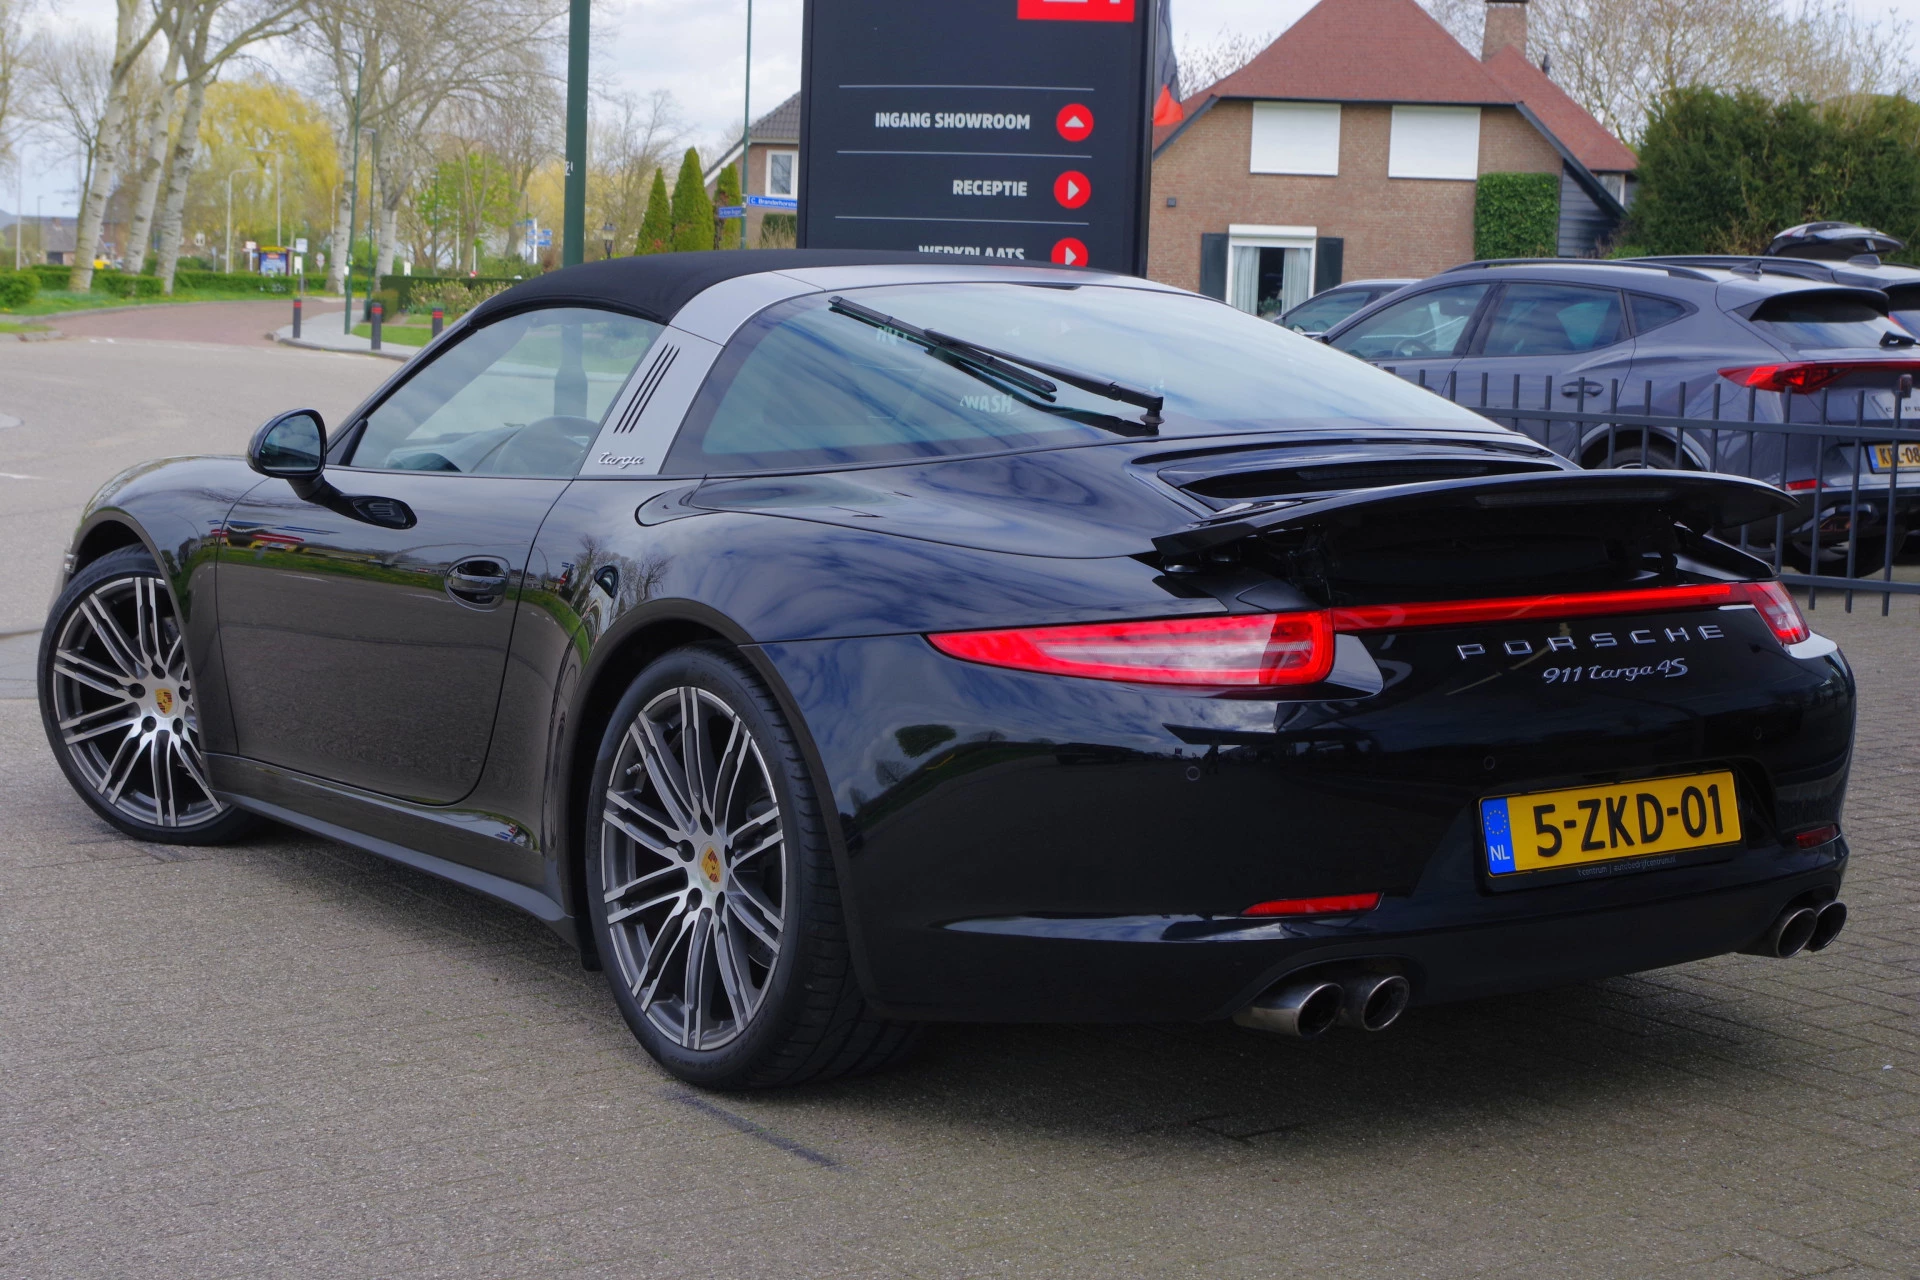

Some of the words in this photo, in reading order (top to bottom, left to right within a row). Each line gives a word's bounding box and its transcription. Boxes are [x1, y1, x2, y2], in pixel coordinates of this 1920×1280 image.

[875, 112, 931, 128] INGANG
[935, 113, 1031, 130] SHOWROOM
[953, 180, 1028, 197] RECEPTIE
[1457, 624, 1725, 660] PORSCHE
[1543, 666, 1583, 684] 911
[1532, 784, 1724, 858] 5-ZKD-01
[1489, 844, 1511, 862] NL
